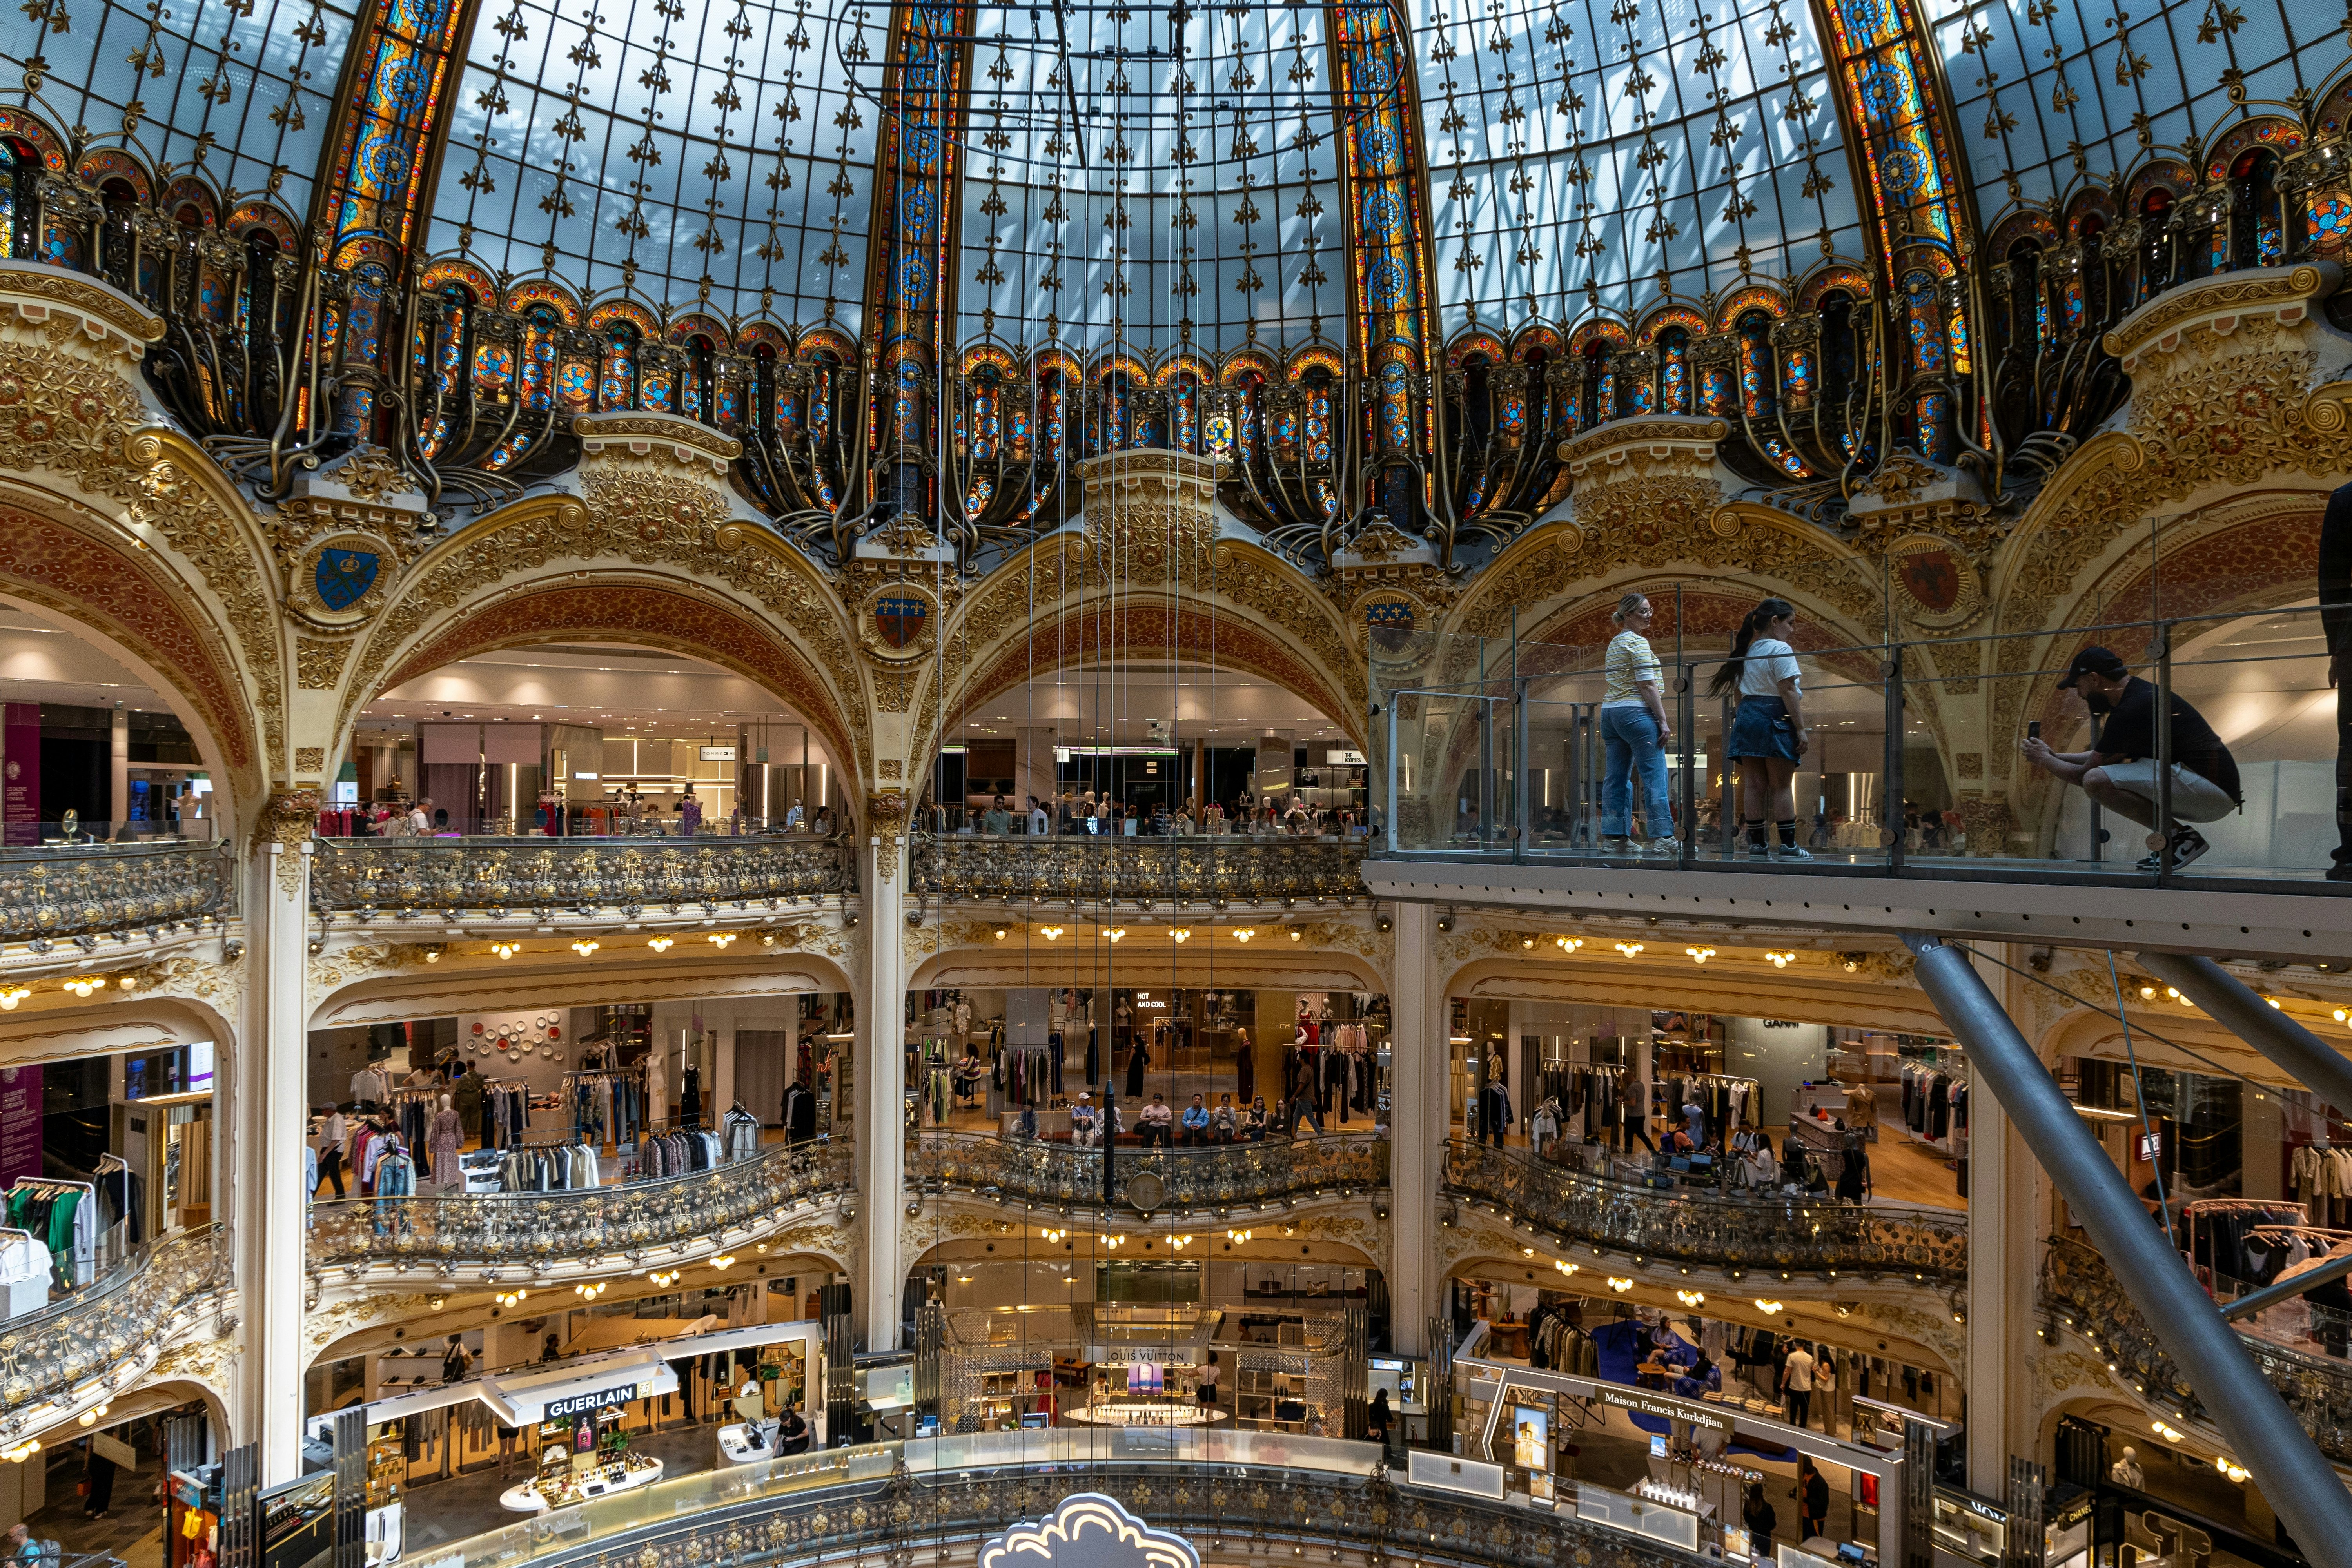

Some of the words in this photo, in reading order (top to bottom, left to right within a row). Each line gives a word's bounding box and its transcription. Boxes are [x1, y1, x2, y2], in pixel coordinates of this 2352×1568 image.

[1763, 1019, 1799, 1028] GANNI
[1140, 1352, 1184, 1361] VUITTON
[550, 1387, 632, 1416] GUERLAIN
[1605, 1392, 1638, 1408] Maison
[1641, 1400, 1675, 1416] Francis
[1677, 1408, 1723, 1428] Kurkdjian
[2069, 1504, 2092, 1522] CHANEL
